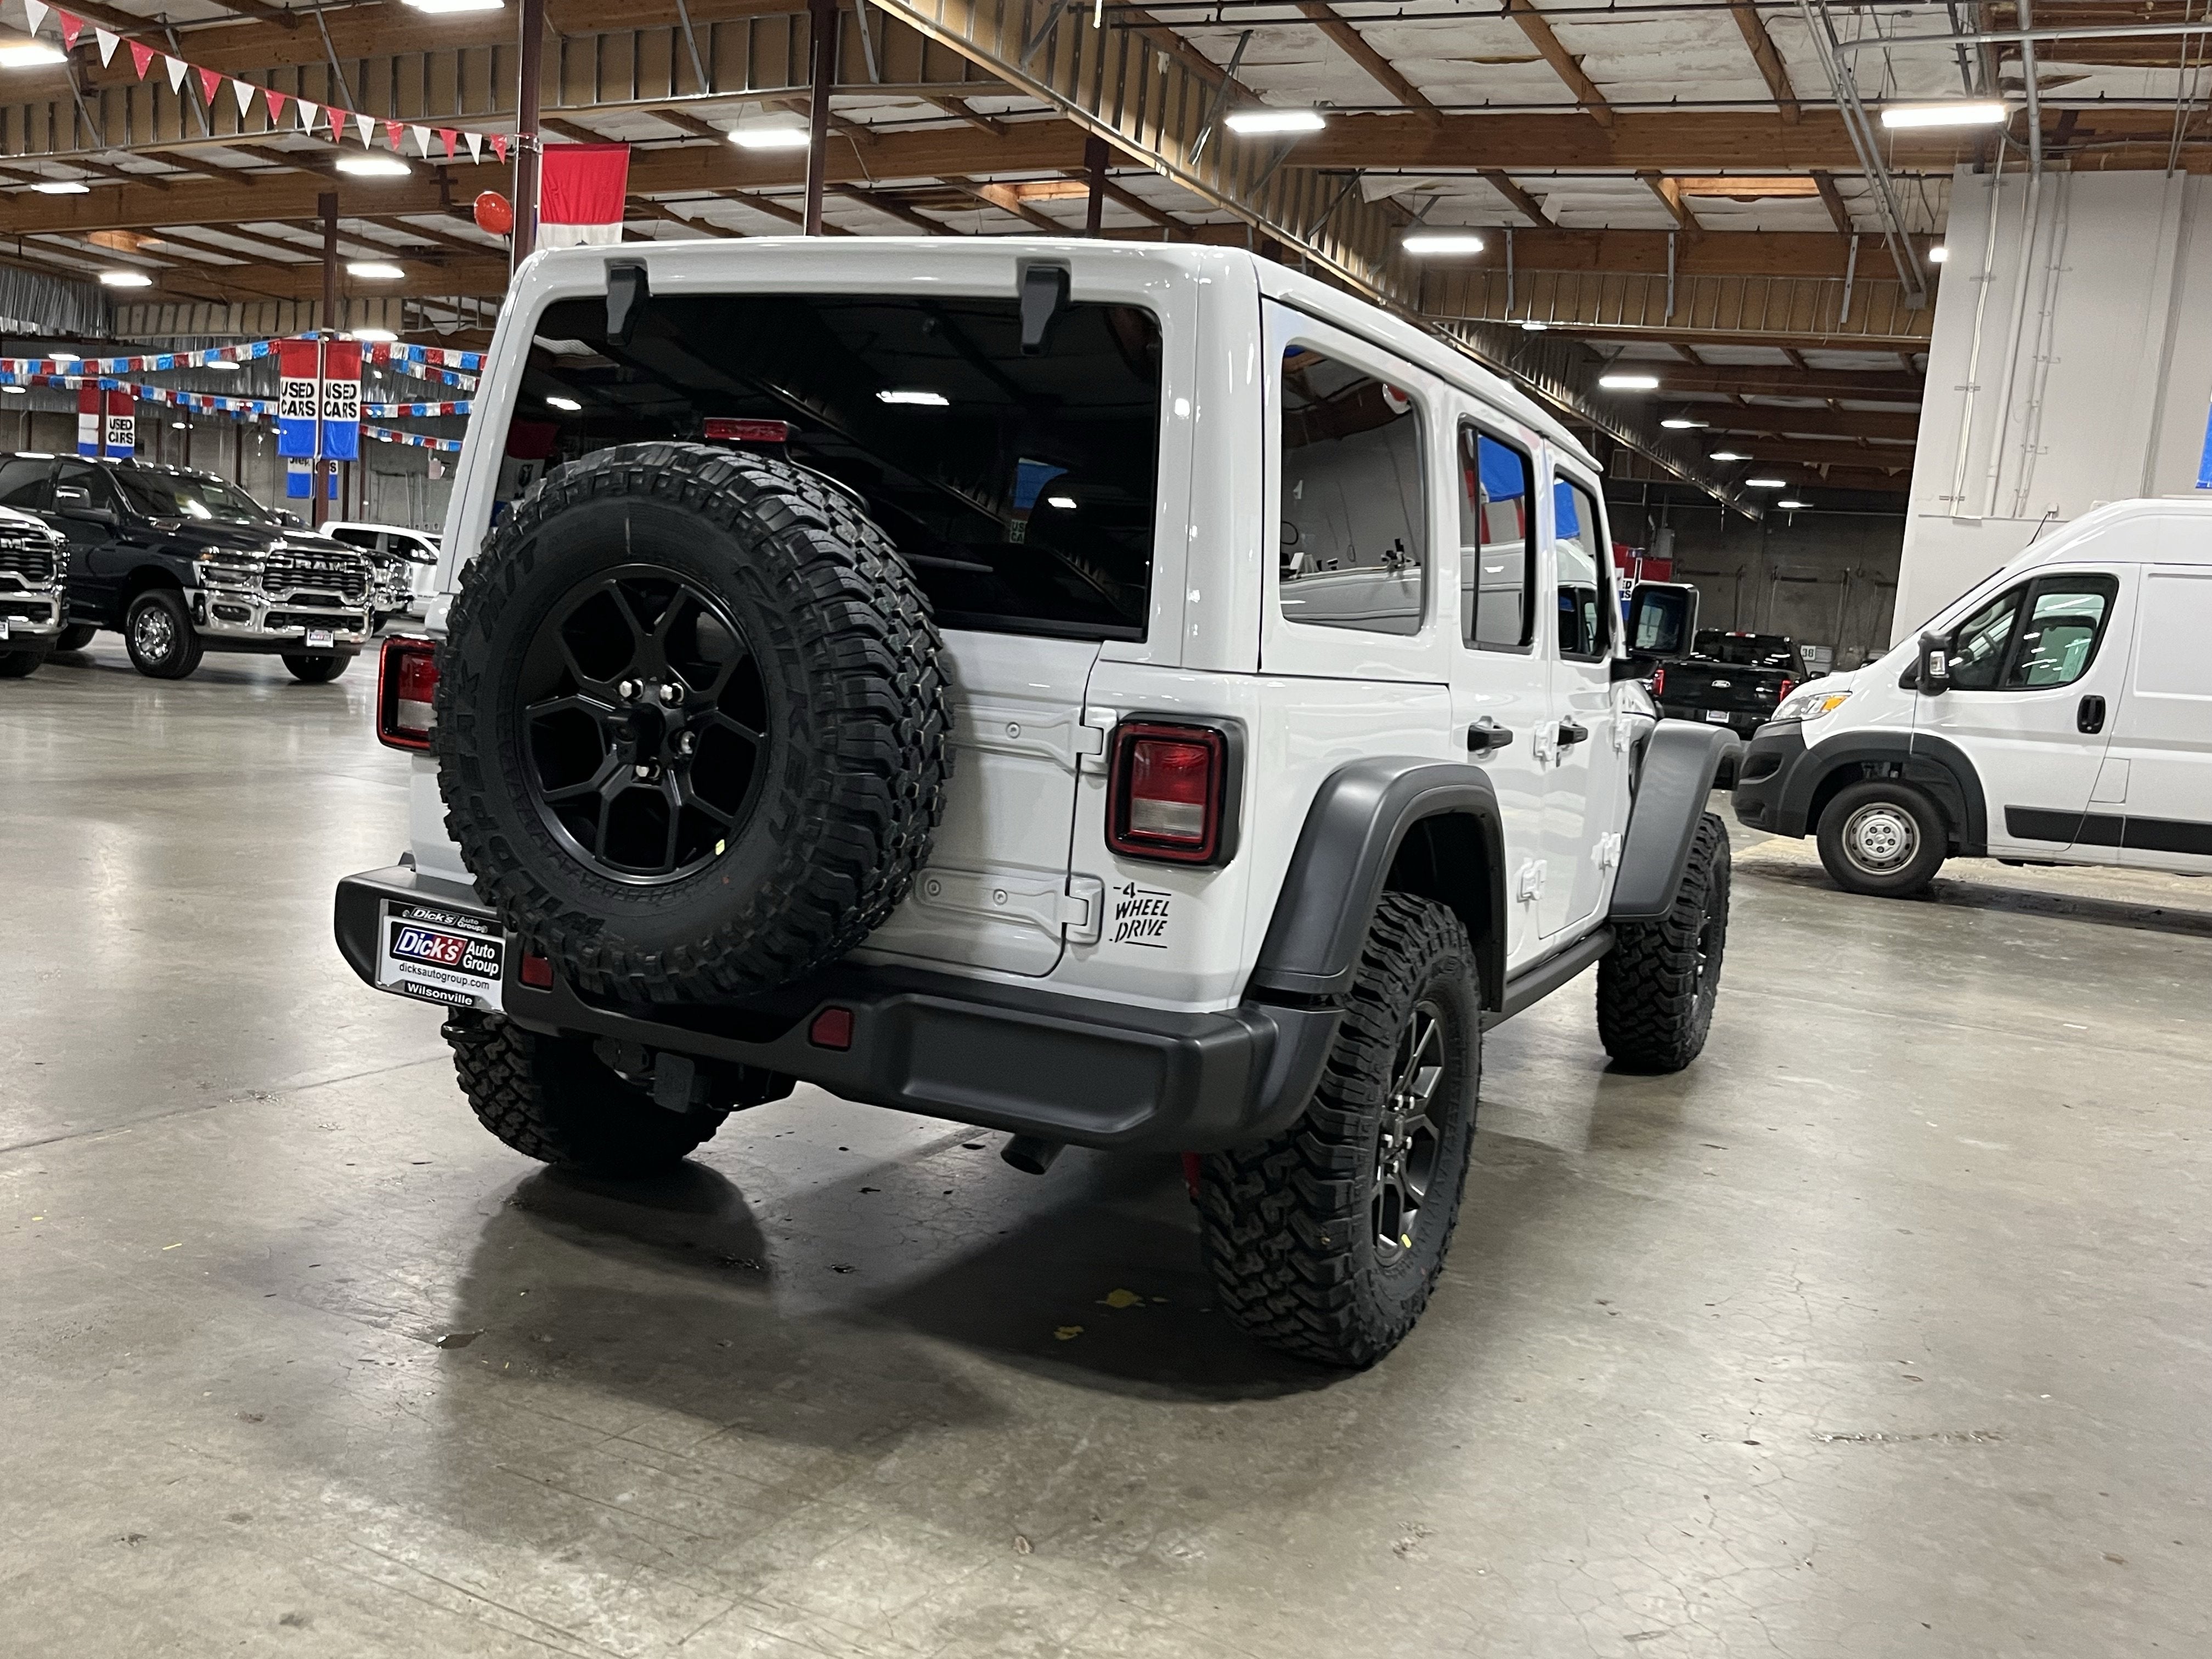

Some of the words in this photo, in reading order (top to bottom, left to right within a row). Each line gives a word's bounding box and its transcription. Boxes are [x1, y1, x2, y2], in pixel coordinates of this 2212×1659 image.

[281, 381, 314, 398] USED
[325, 382, 357, 399] USED
[281, 399, 315, 416] CARS
[324, 402, 357, 418] CARS
[110, 418, 133, 430] USED
[295, 559, 345, 572] RAM
[1802, 648, 1814, 658] 38
[1122, 882, 1136, 899] 4
[413, 909, 455, 925] Dick's
[1115, 899, 1170, 921] WHEEL
[457, 922, 482, 932] Group
[460, 917, 479, 925] Auto
[1114, 919, 1168, 943] DRIVE
[398, 930, 459, 961] Dick's
[466, 941, 495, 959] Auto
[462, 955, 499, 976] Group
[399, 962, 490, 990] dicksautogroup.com
[407, 983, 473, 1006] Wilsonville
